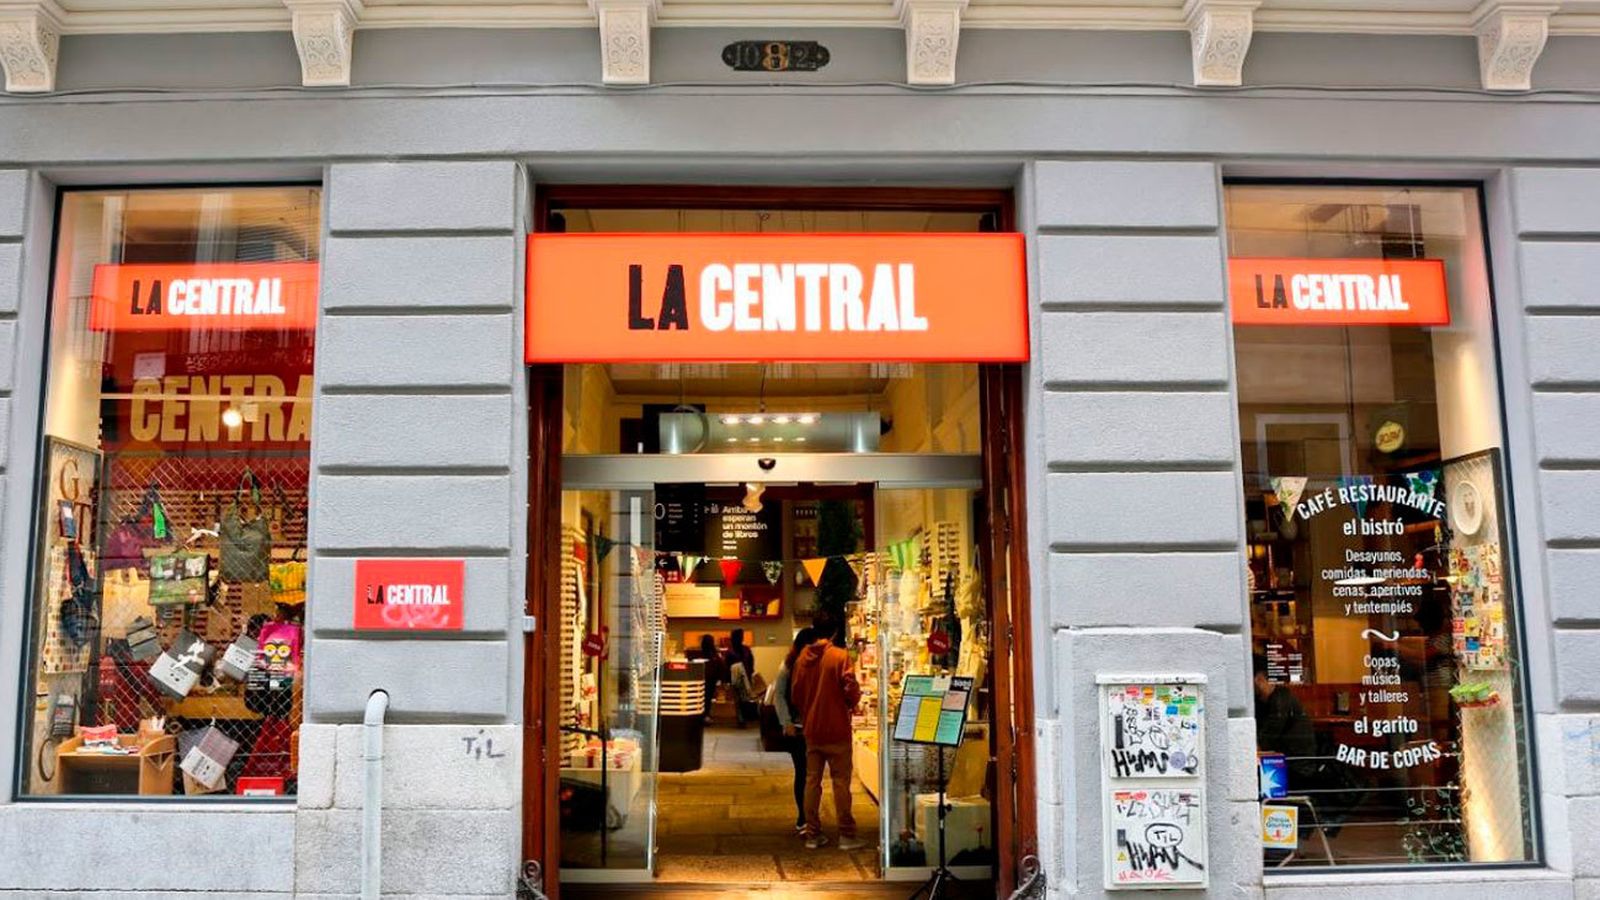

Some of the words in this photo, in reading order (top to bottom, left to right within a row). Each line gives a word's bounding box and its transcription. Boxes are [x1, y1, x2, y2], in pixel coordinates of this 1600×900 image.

[131, 280, 162, 315] LA
[167, 277, 286, 315] CENTRAL
[628, 264, 689, 331] LA
[699, 263, 929, 332] CENTRAL
[1255, 274, 1288, 309] LA
[1291, 274, 1409, 311] CENTRAL
[1296, 487, 1337, 520] CAFÉ
[1338, 484, 1446, 519] RESTAURANTE
[1343, 518, 1356, 536] el
[1361, 517, 1404, 536] bistró
[1346, 549, 1405, 564] Desayunos,
[1373, 567, 1431, 581] meriendas,
[387, 584, 451, 606] CENTRAL
[1333, 587, 1368, 599] cenas,
[1370, 585, 1423, 599] aperitivos
[1345, 604, 1351, 616] y
[1353, 601, 1413, 616] tentempiés
[1363, 654, 1400, 670] Copas,
[1362, 672, 1401, 686] música
[1360, 692, 1367, 706] y
[1368, 690, 1409, 703] talleres
[1354, 716, 1368, 734] el
[1372, 716, 1418, 737] garito
[1336, 743, 1366, 768] BAR
[1370, 751, 1390, 770] DE
[1393, 741, 1441, 769] COPAS
